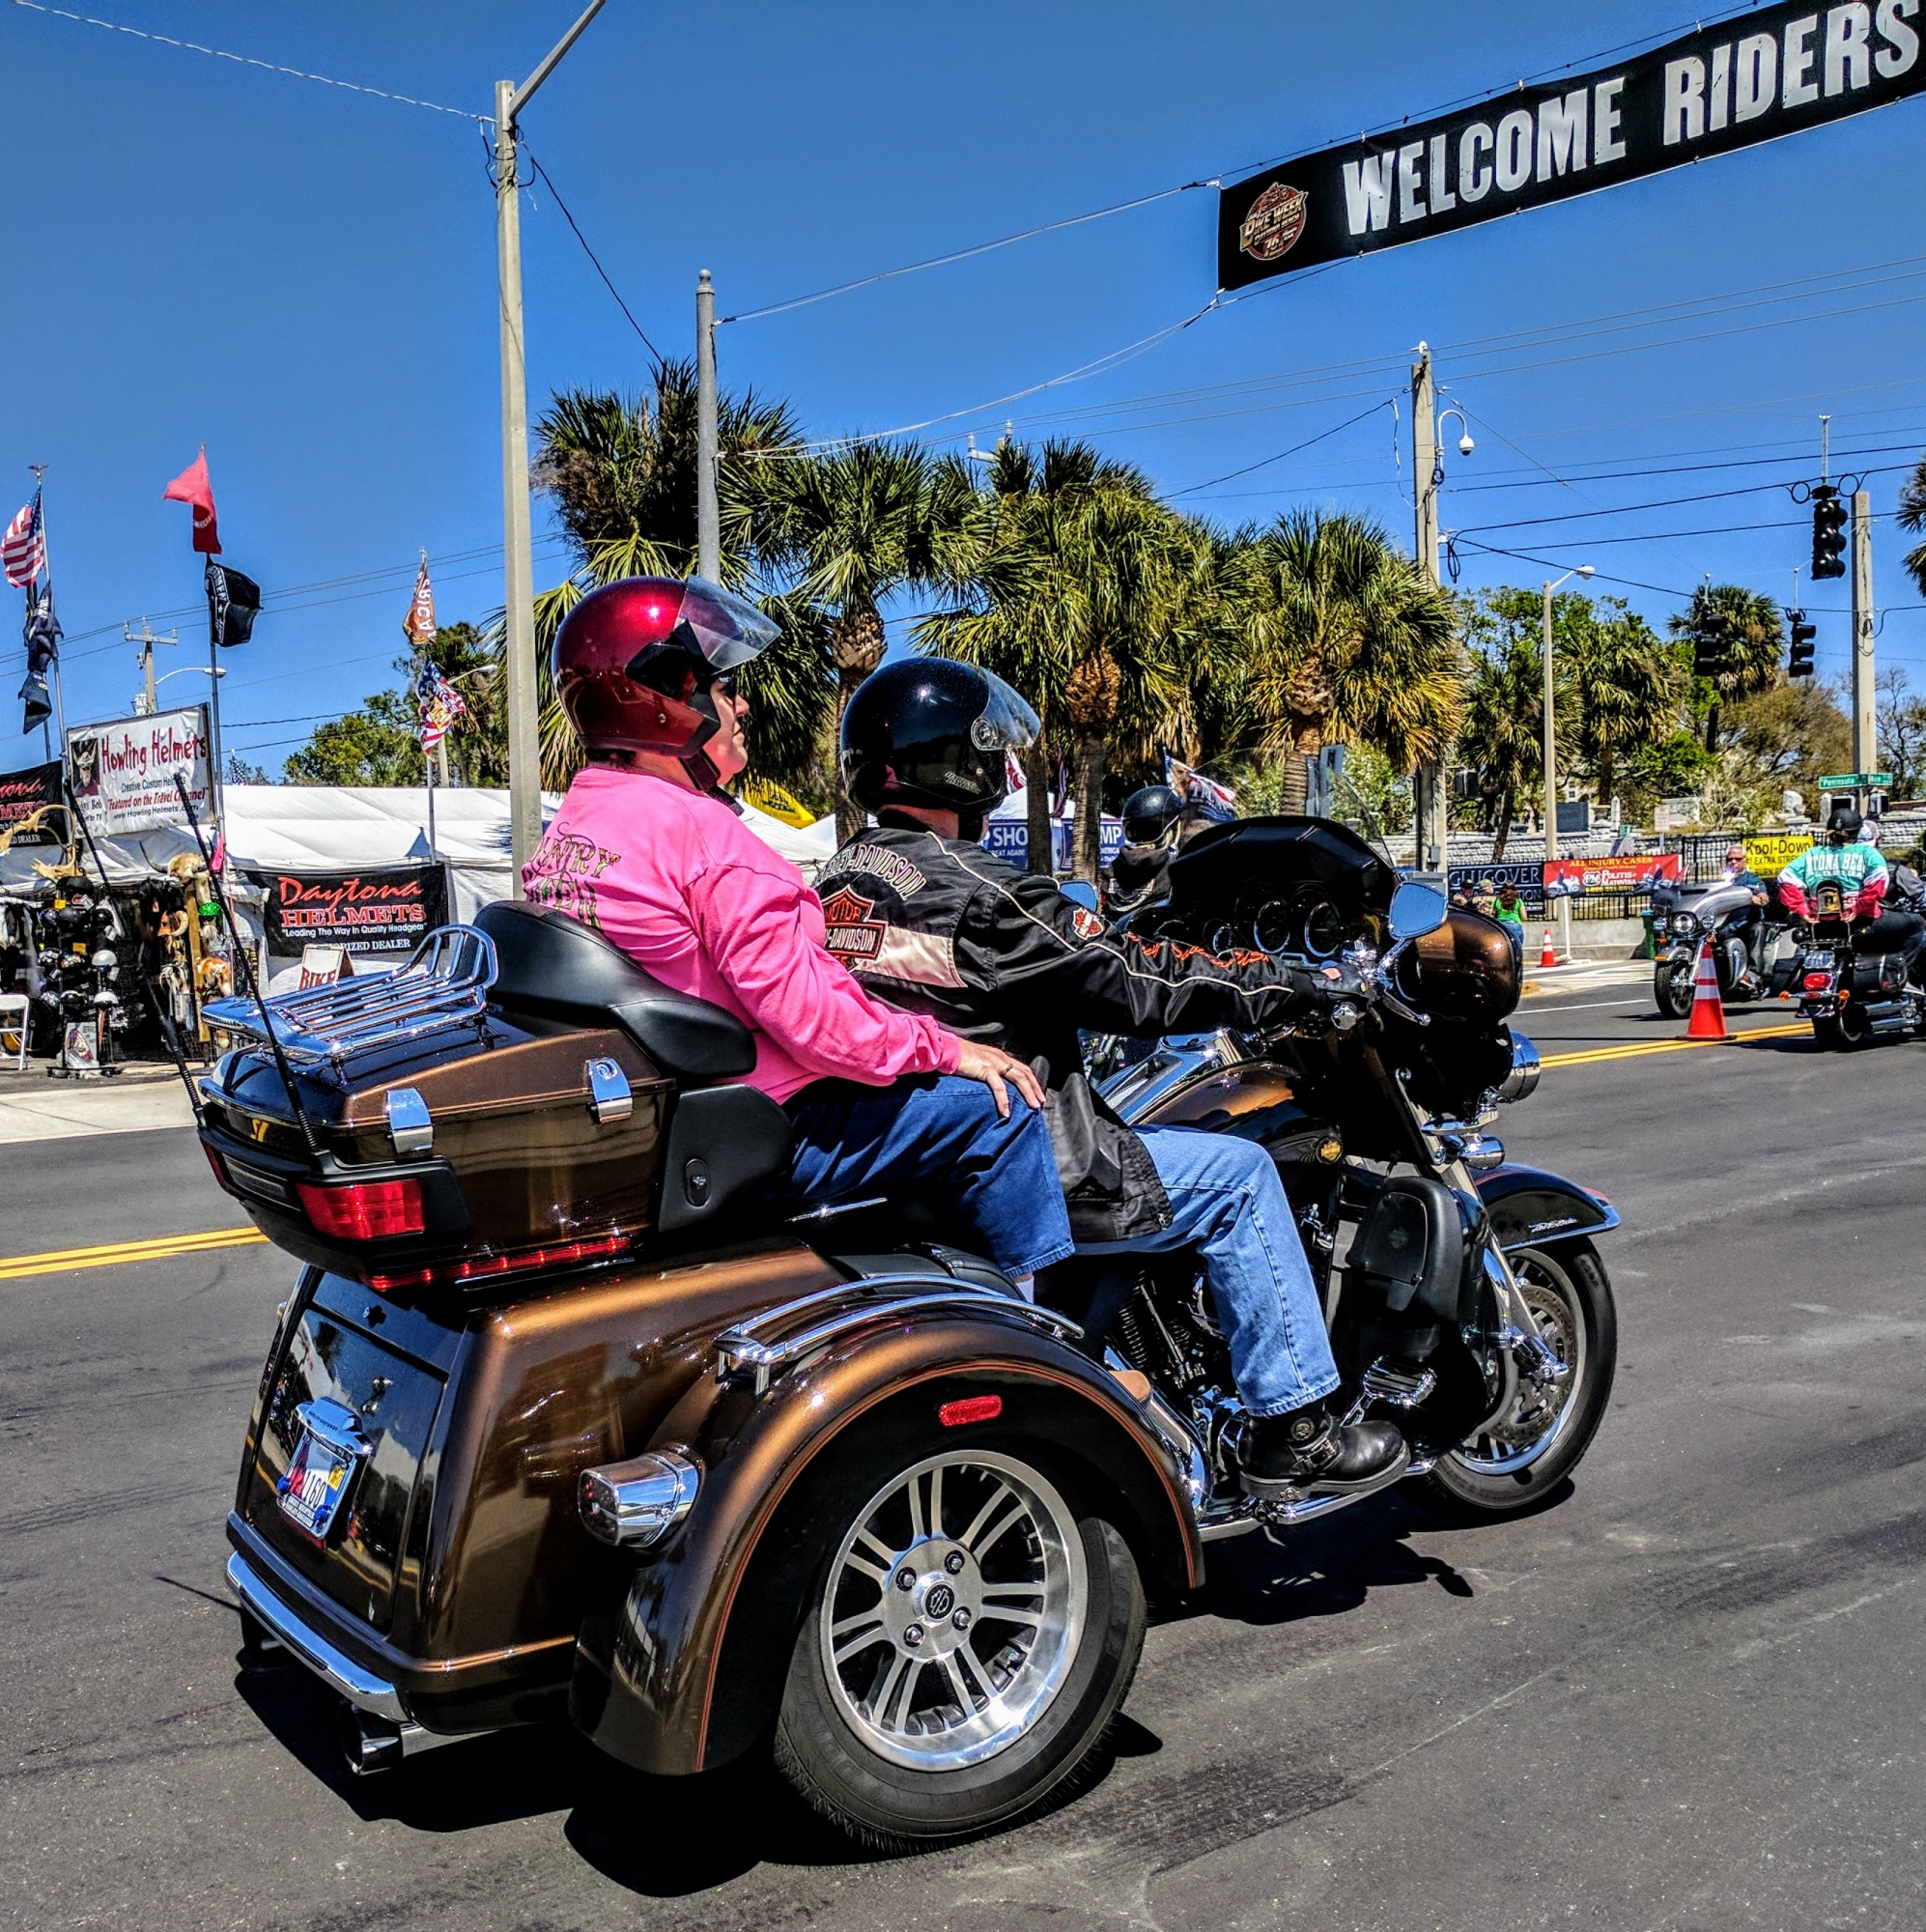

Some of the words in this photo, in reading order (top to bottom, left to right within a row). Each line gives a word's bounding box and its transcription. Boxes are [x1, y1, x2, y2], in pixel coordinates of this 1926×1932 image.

[1342, 76, 1627, 236] WELCOME
[1662, 0, 1920, 147] RIDERS
[1274, 194, 1304, 225] WEEK
[101, 734, 147, 776] Howling
[152, 726, 207, 768] Helmets
[121, 781, 142, 794] Creative
[141, 779, 163, 790] Custom
[132, 796, 142, 807] on
[143, 793, 153, 806] the
[154, 789, 174, 805] Travel
[1588, 858, 1621, 867] INJURY
[1623, 856, 1653, 865] CASES
[1754, 856, 1776, 866] EXTRA
[277, 876, 424, 912] Daytona
[279, 903, 427, 928] HELMETS
[318, 926, 332, 937] The
[333, 926, 352, 937] Way
[352, 924, 360, 935] In
[360, 923, 387, 935] Quality
[371, 938, 411, 951] DEALER
